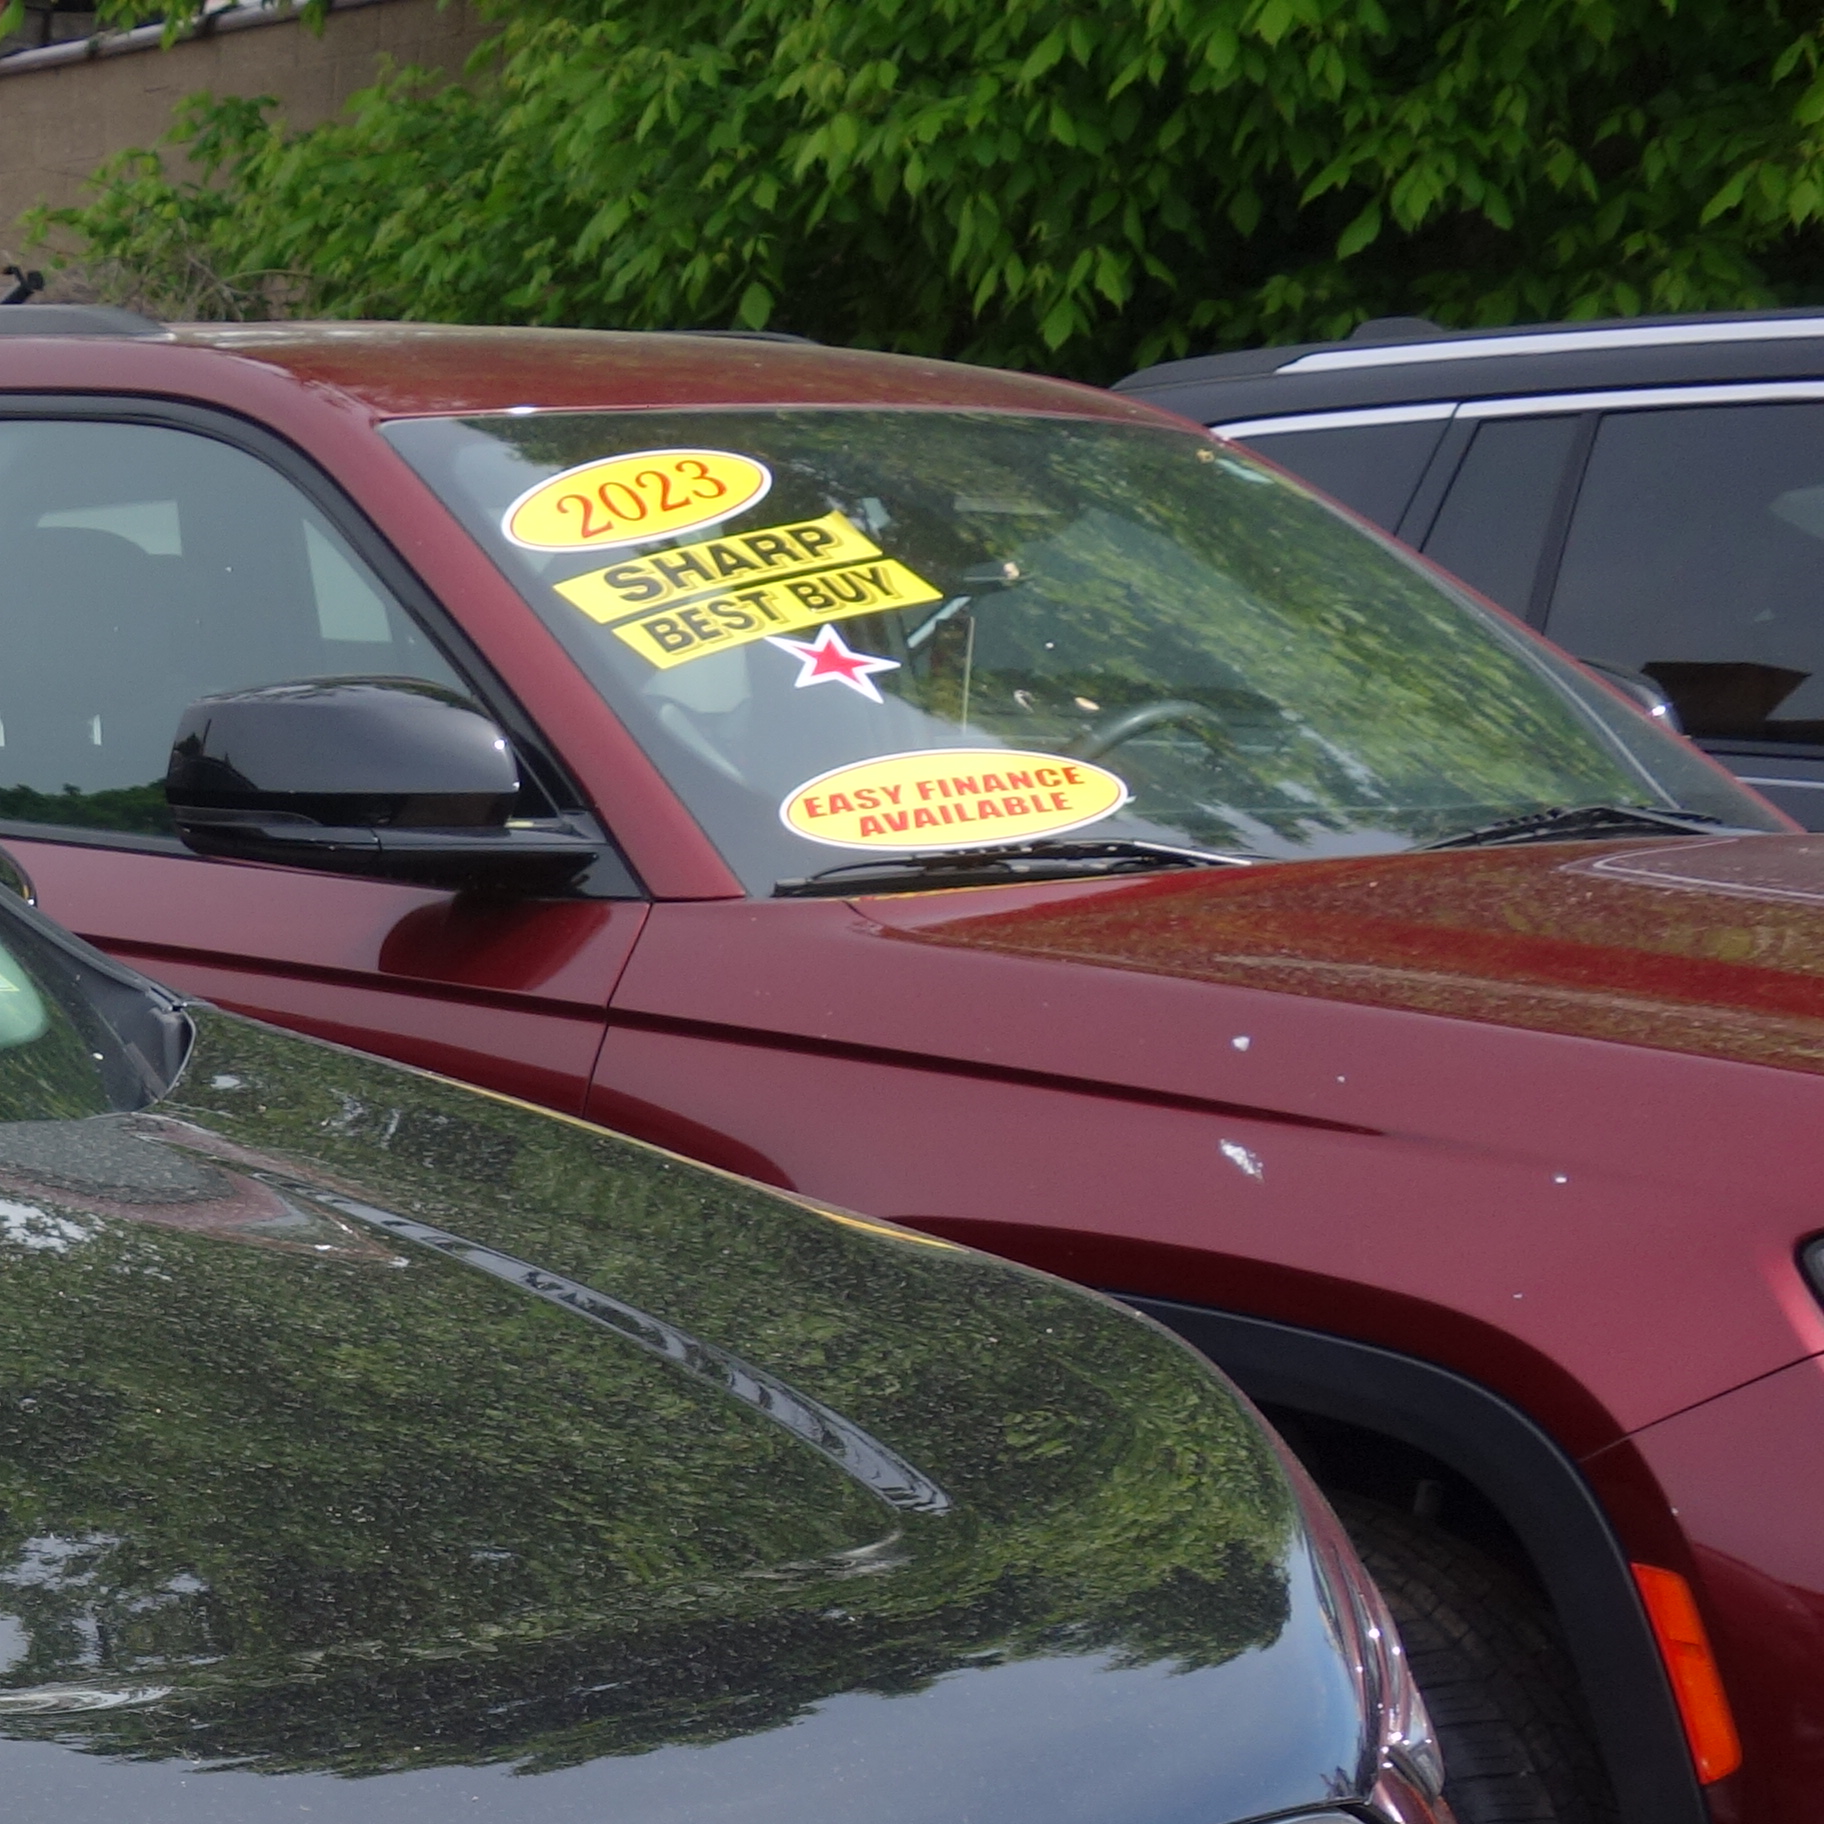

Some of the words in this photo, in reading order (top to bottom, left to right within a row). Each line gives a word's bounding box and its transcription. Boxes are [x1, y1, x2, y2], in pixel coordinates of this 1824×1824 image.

[556, 460, 727, 538] 2023
[603, 524, 842, 604] SHARP
[643, 591, 779, 656] BEST
[785, 567, 897, 611] BUY
[803, 785, 902, 819] EASY
[916, 766, 1085, 801] FINANCE
[858, 792, 1074, 837] AVAILABLE
